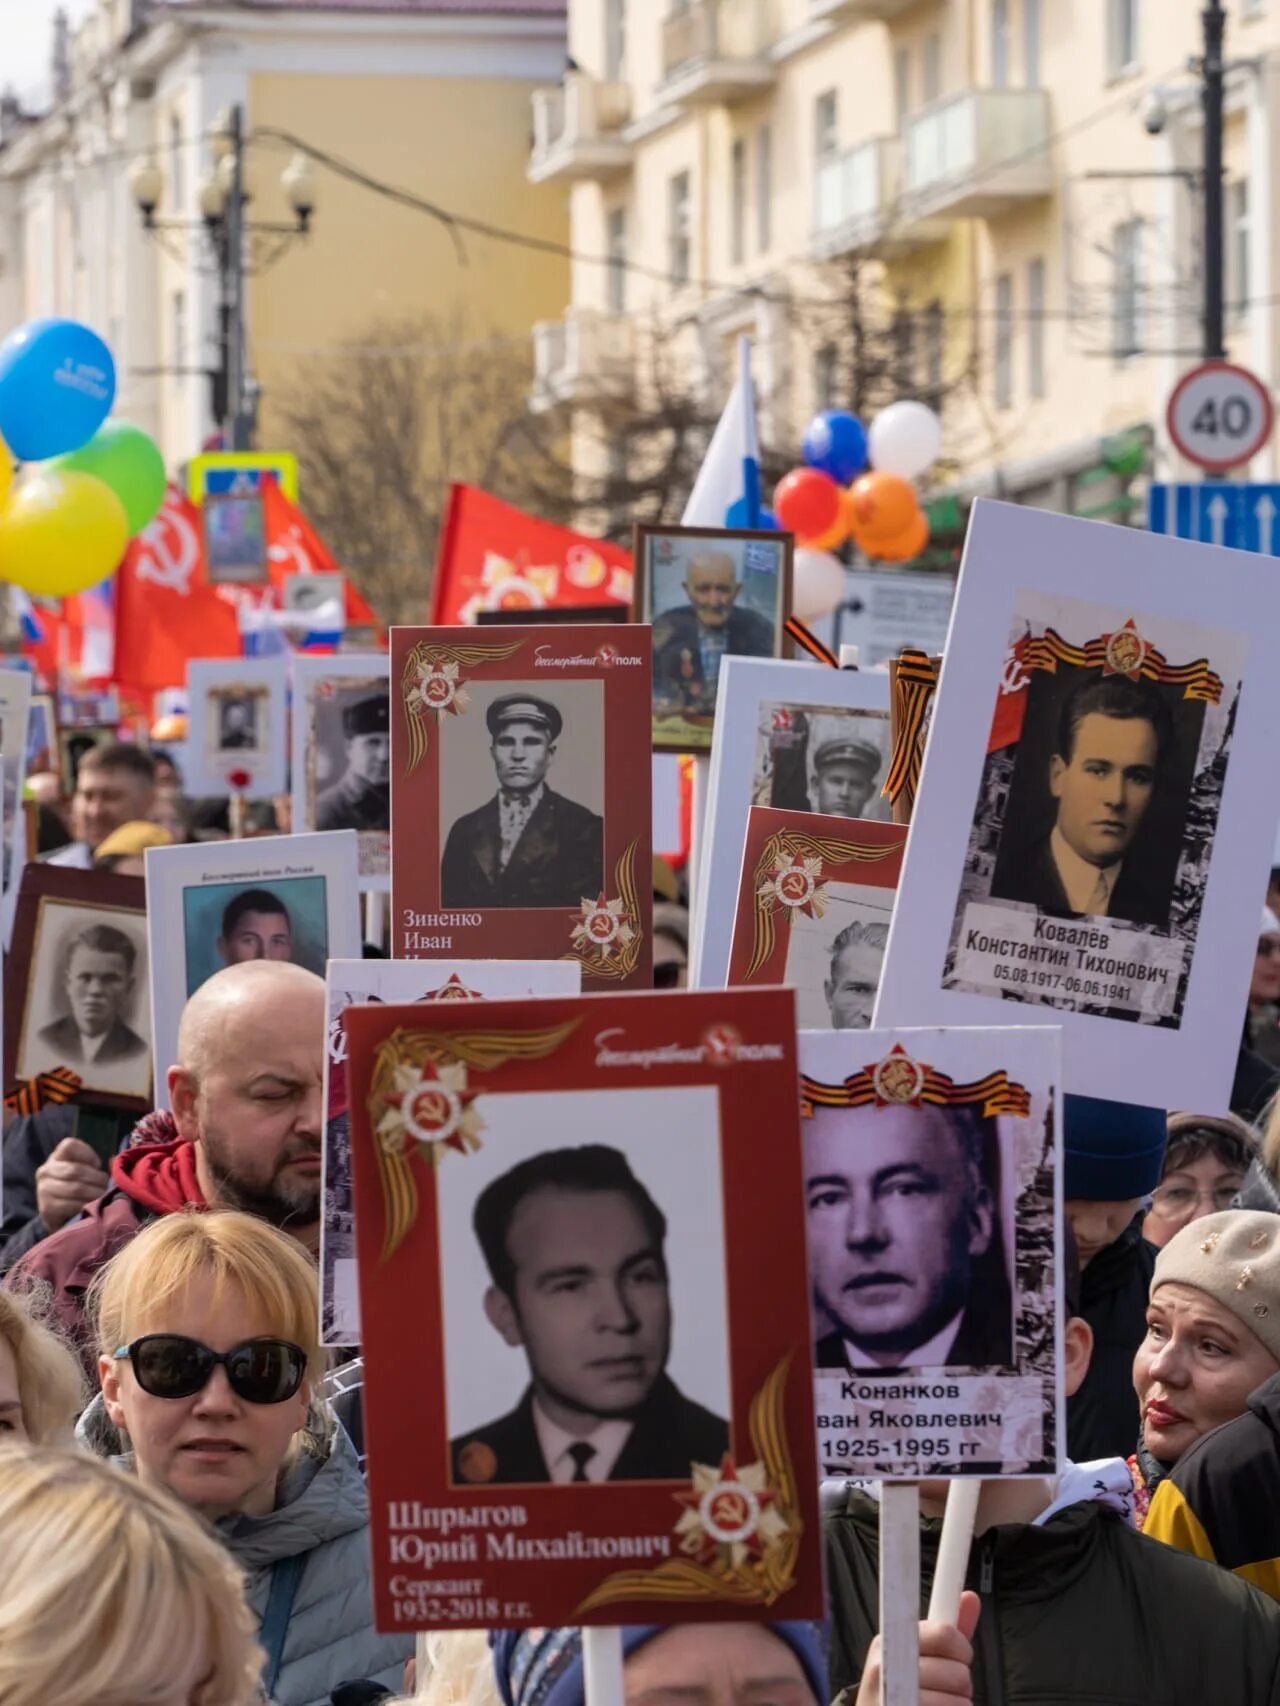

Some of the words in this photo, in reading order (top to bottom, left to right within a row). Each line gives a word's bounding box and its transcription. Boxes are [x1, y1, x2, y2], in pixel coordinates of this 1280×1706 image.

[1190, 395, 1251, 439] 40
[403, 909, 482, 927] Зиненко
[404, 931, 453, 949] Иван
[1033, 917, 1110, 949] Ковалёв
[966, 929, 1070, 969] Константин
[1075, 949, 1169, 985] Тихонович
[841, 1381, 960, 1399] Конанков
[816, 1414, 860, 1428] ван
[869, 1410, 1002, 1428] Яковлевич
[823, 1438, 950, 1457] 1925-1995
[959, 1441, 982, 1456] гг
[388, 1502, 528, 1534] Шпрыгов
[389, 1534, 477, 1569] Юрий
[486, 1531, 670, 1561] Михайлович
[389, 1576, 484, 1600] Сержант
[393, 1599, 499, 1621] 1932-2018
[504, 1603, 533, 1619] г.г.
